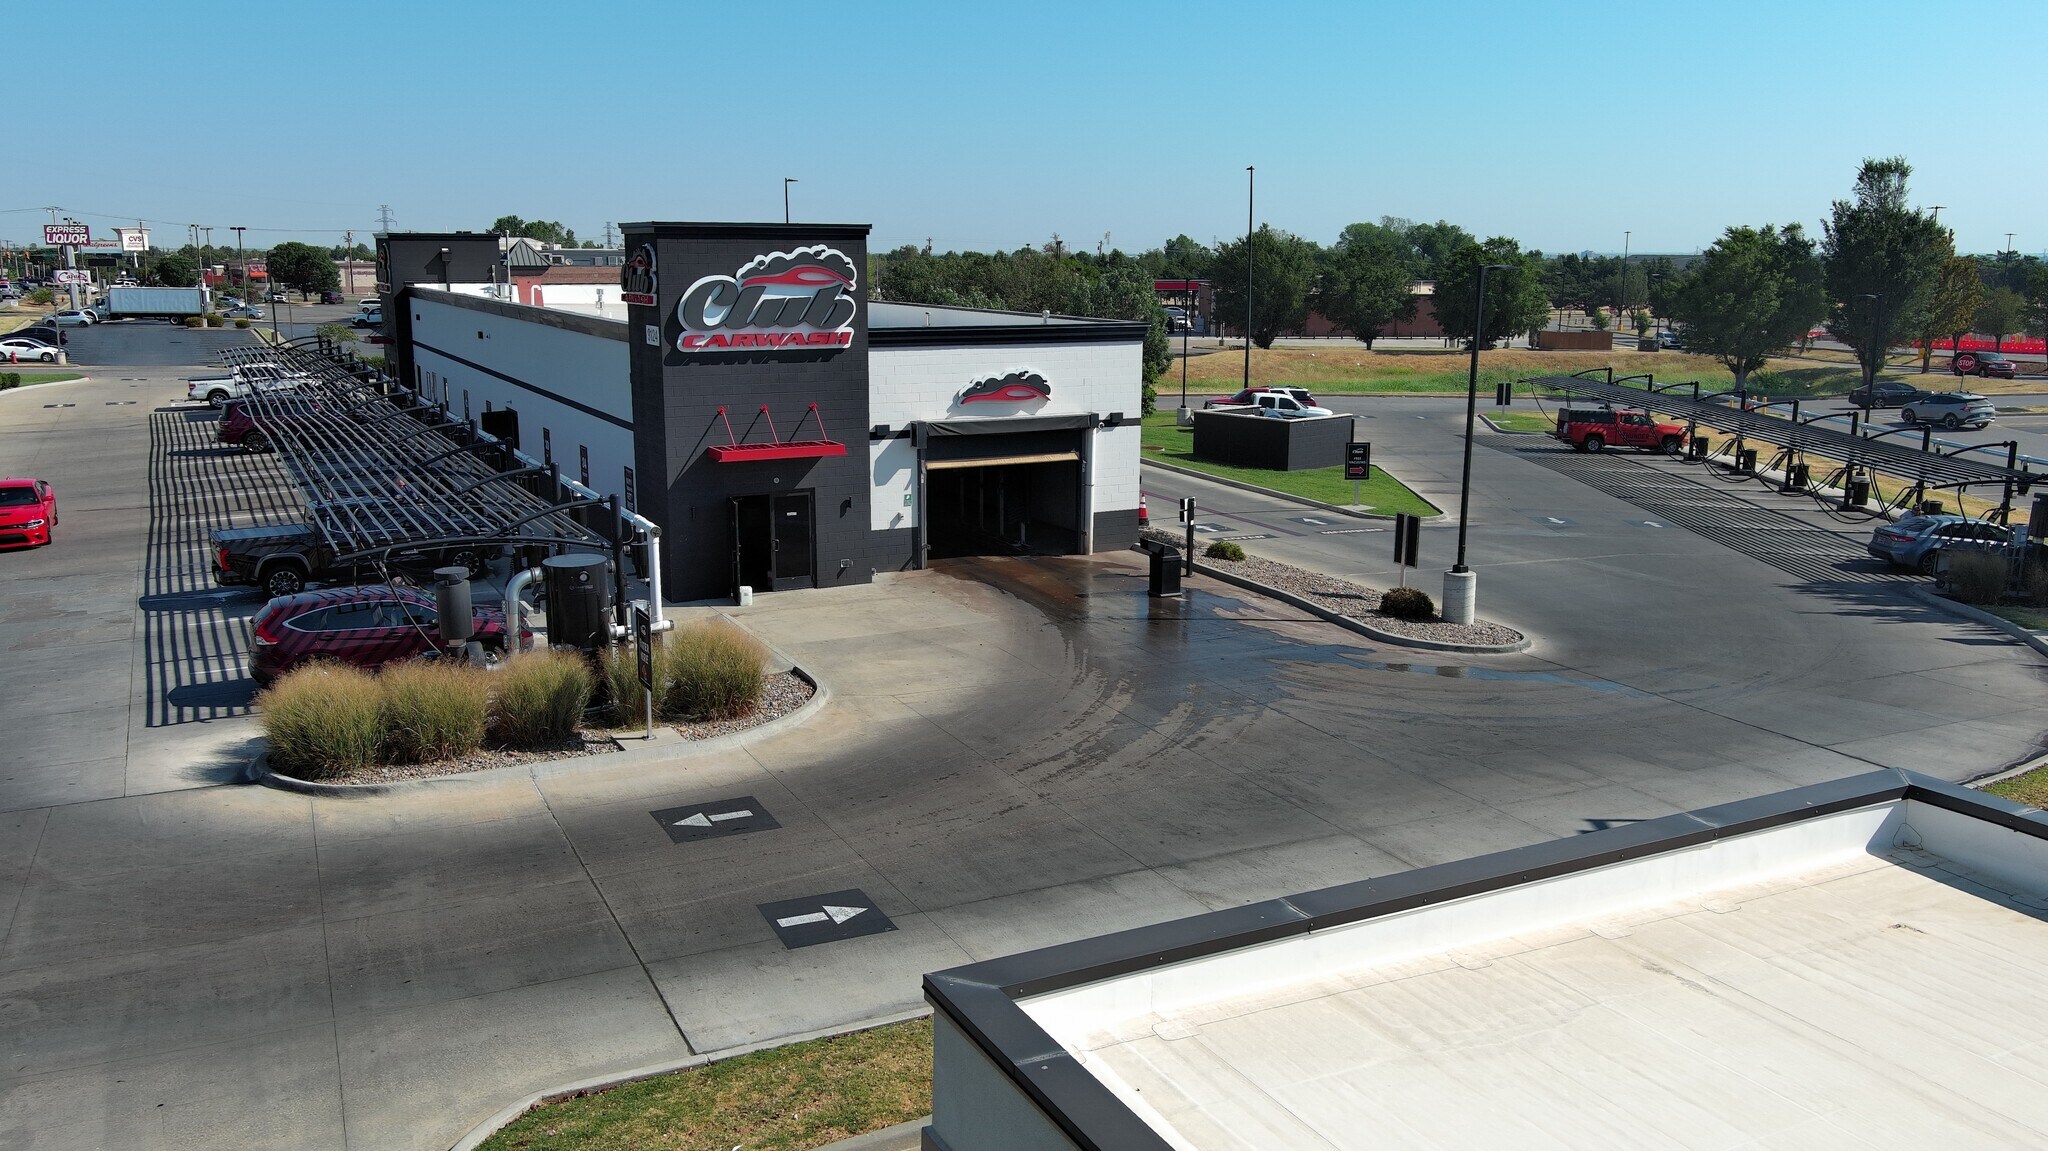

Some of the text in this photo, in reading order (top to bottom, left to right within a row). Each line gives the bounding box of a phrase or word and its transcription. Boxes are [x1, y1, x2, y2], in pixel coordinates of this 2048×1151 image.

[46, 233, 87, 244] LIQUOR
[86, 241, 118, 249] algreens
[683, 280, 854, 332] Club
[682, 332, 852, 349] CARWASH
